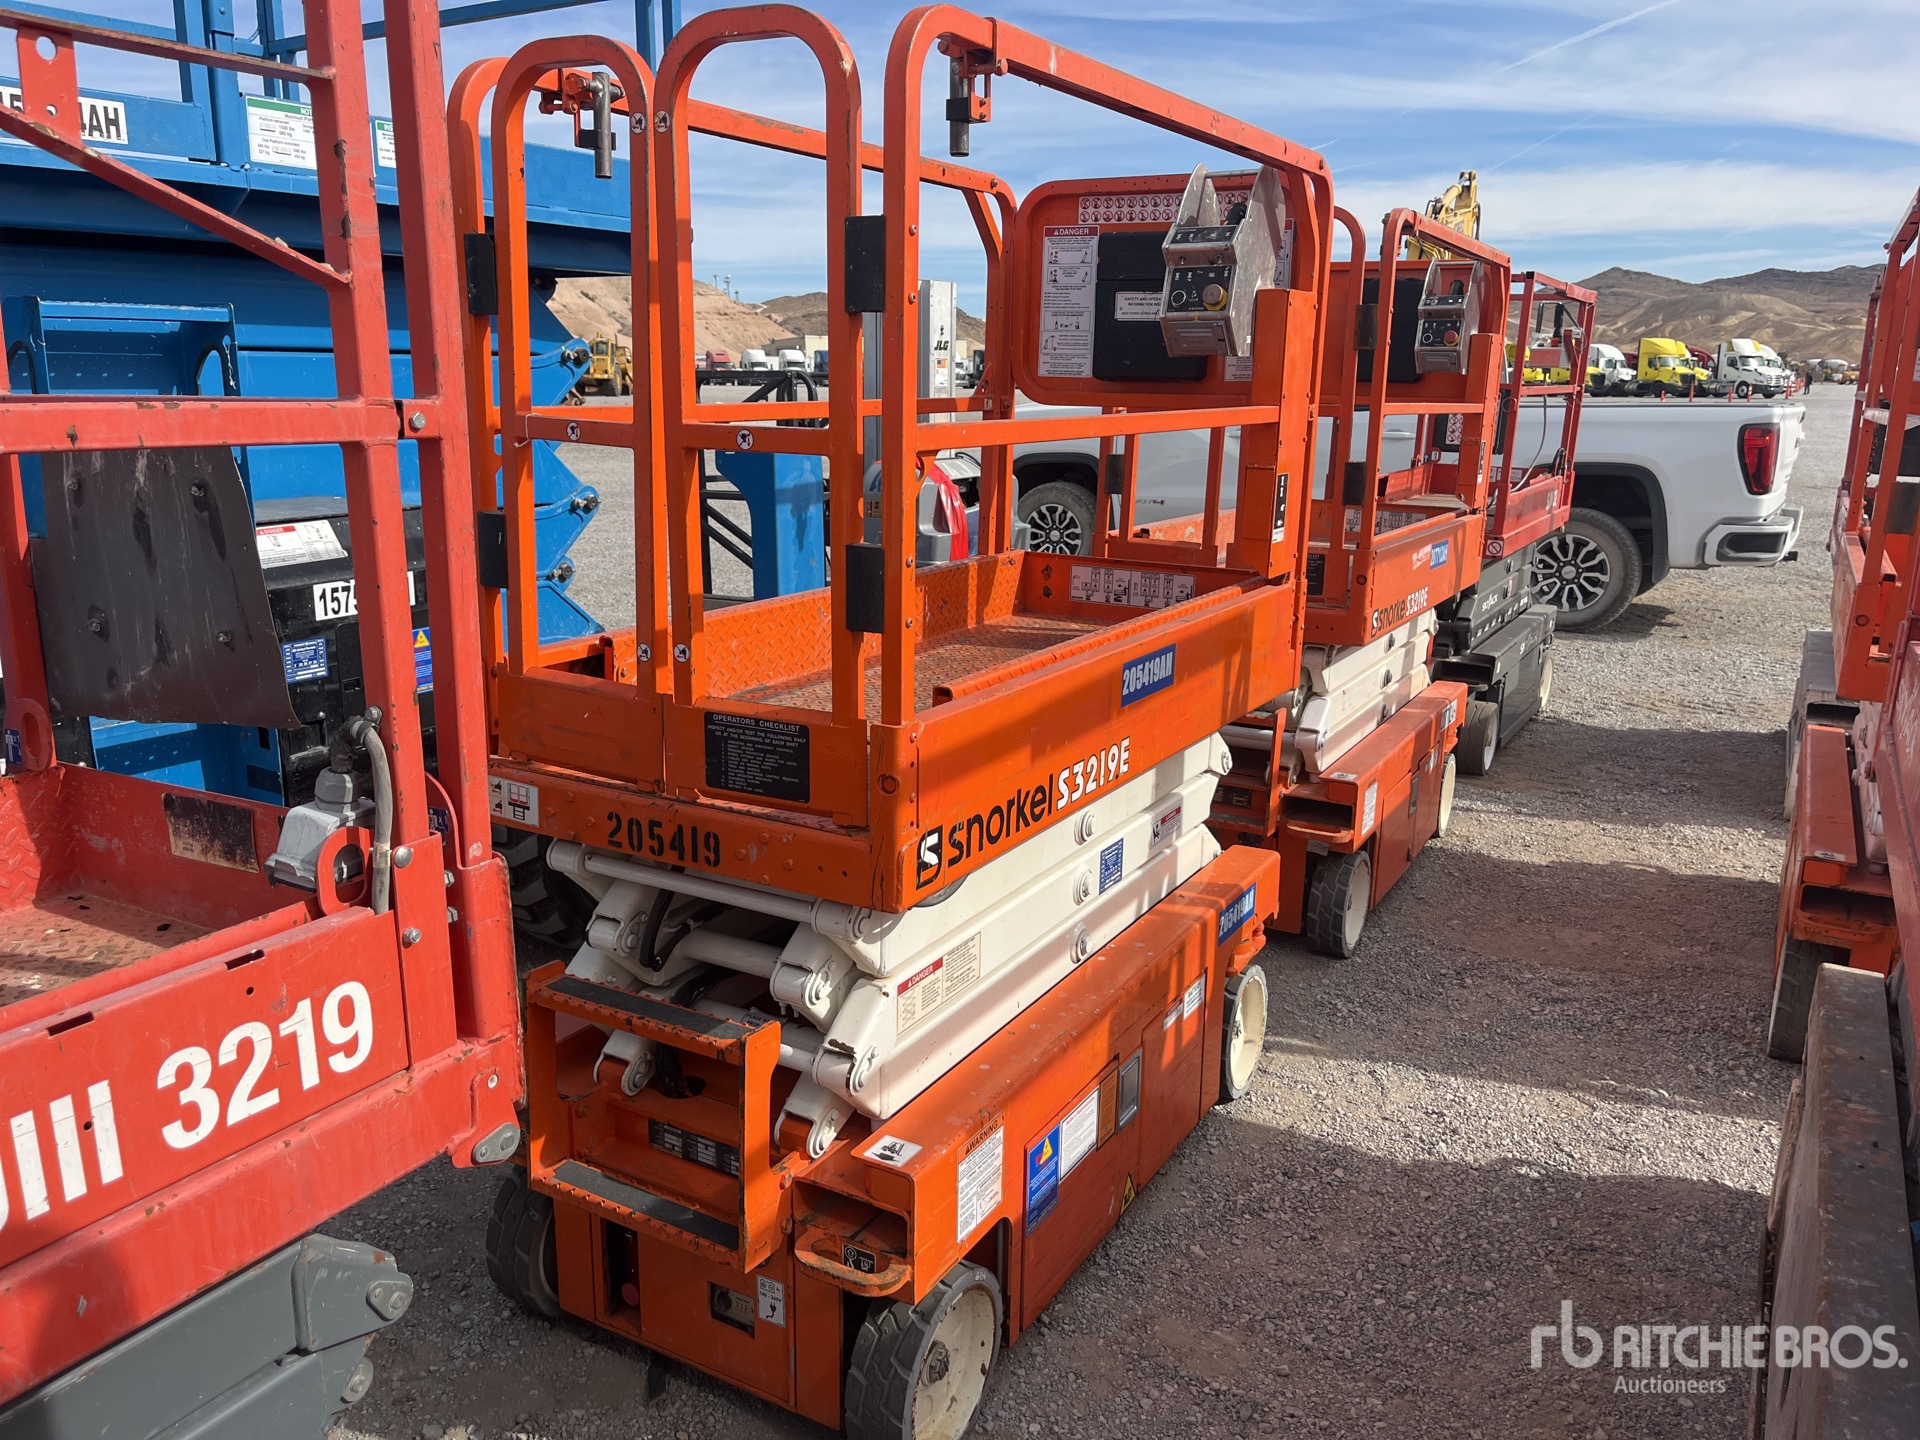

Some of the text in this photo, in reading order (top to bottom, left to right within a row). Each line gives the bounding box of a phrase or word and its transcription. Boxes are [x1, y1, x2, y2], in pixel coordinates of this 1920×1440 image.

[1060, 228, 1089, 236] DANGER
[934, 340, 949, 351] JLG
[319, 584, 358, 616] 157
[1122, 651, 1173, 696] 205419AH
[713, 713, 800, 732] OPERATORS CHECKLIST
[948, 774, 1054, 868] snorkel
[1057, 736, 1131, 812] S3219E
[607, 812, 719, 867] 205419
[157, 981, 373, 1149] 3219
[970, 1120, 998, 1150] WARNING
